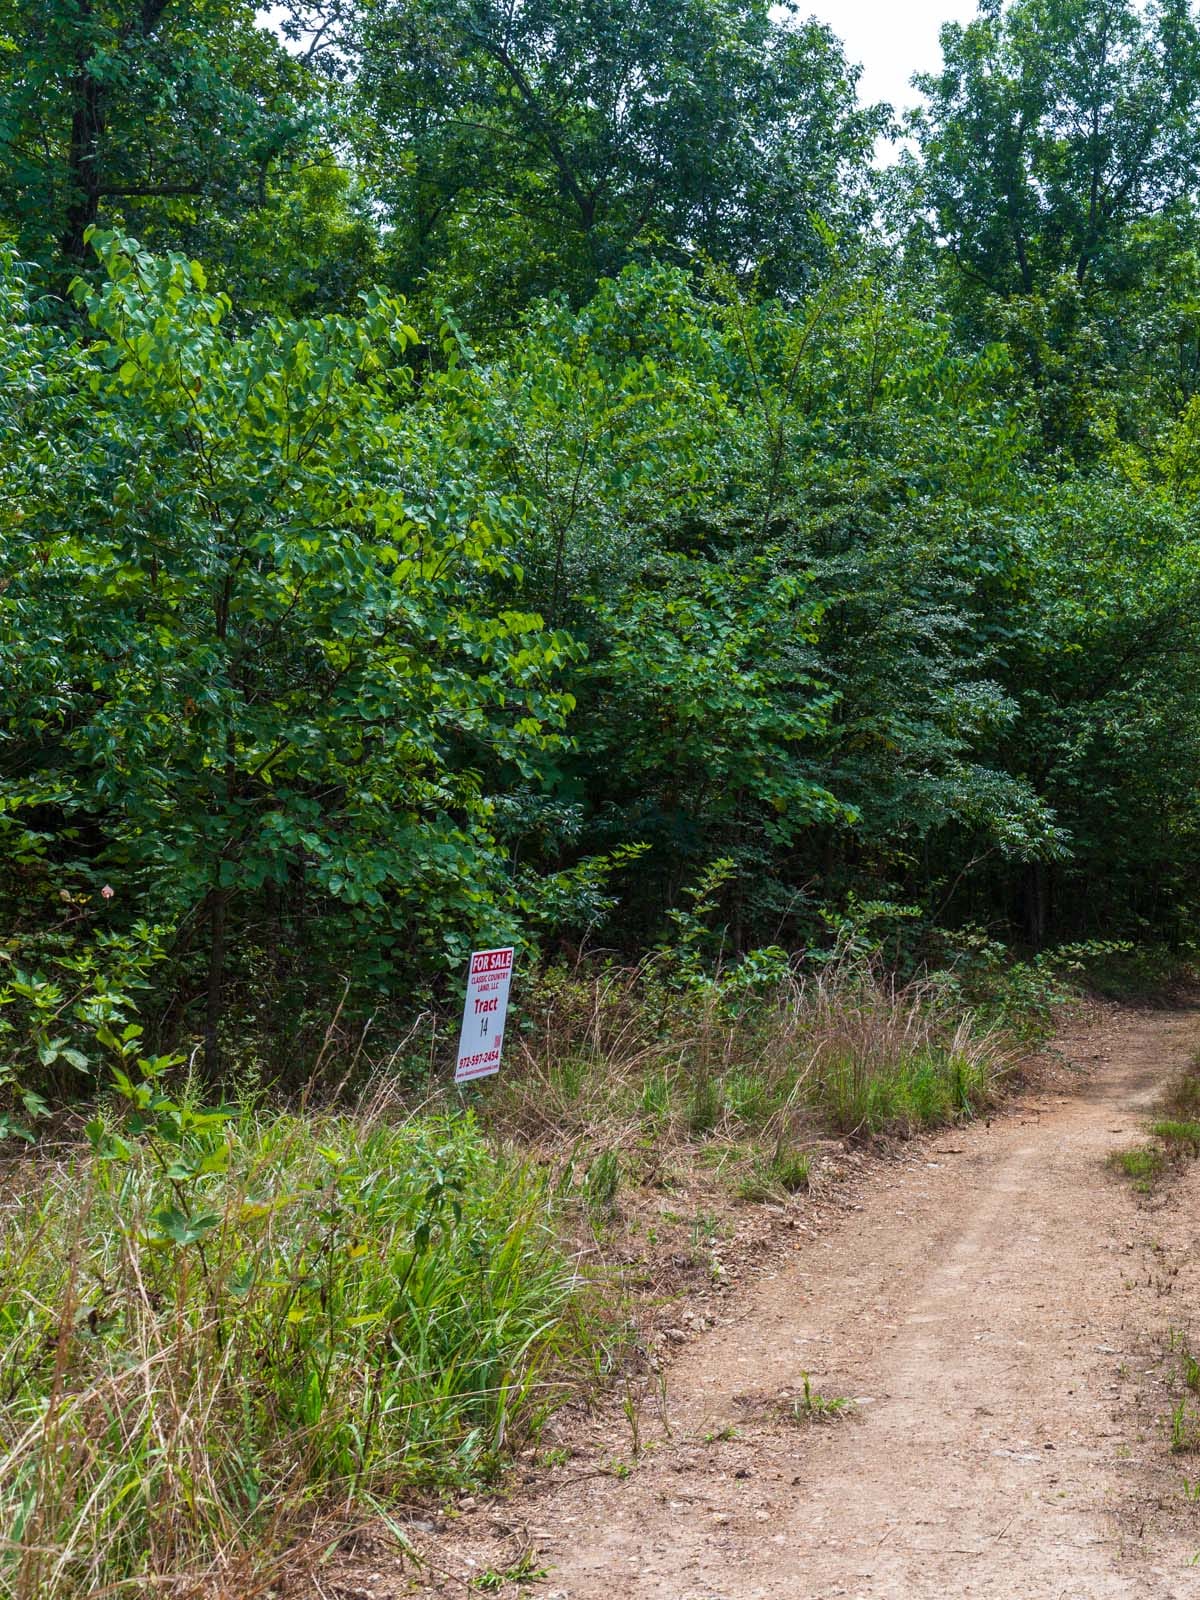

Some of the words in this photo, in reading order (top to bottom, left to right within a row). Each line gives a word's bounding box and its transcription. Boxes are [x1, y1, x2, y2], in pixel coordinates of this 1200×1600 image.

[473, 955, 489, 971] FOR
[490, 952, 511, 969] SALE
[472, 974, 488, 984] CLASSIC
[488, 972, 508, 982] COUNTRY
[491, 982, 499, 990] LLC
[475, 997, 498, 1014] Tract
[480, 1017, 488, 1037] 14
